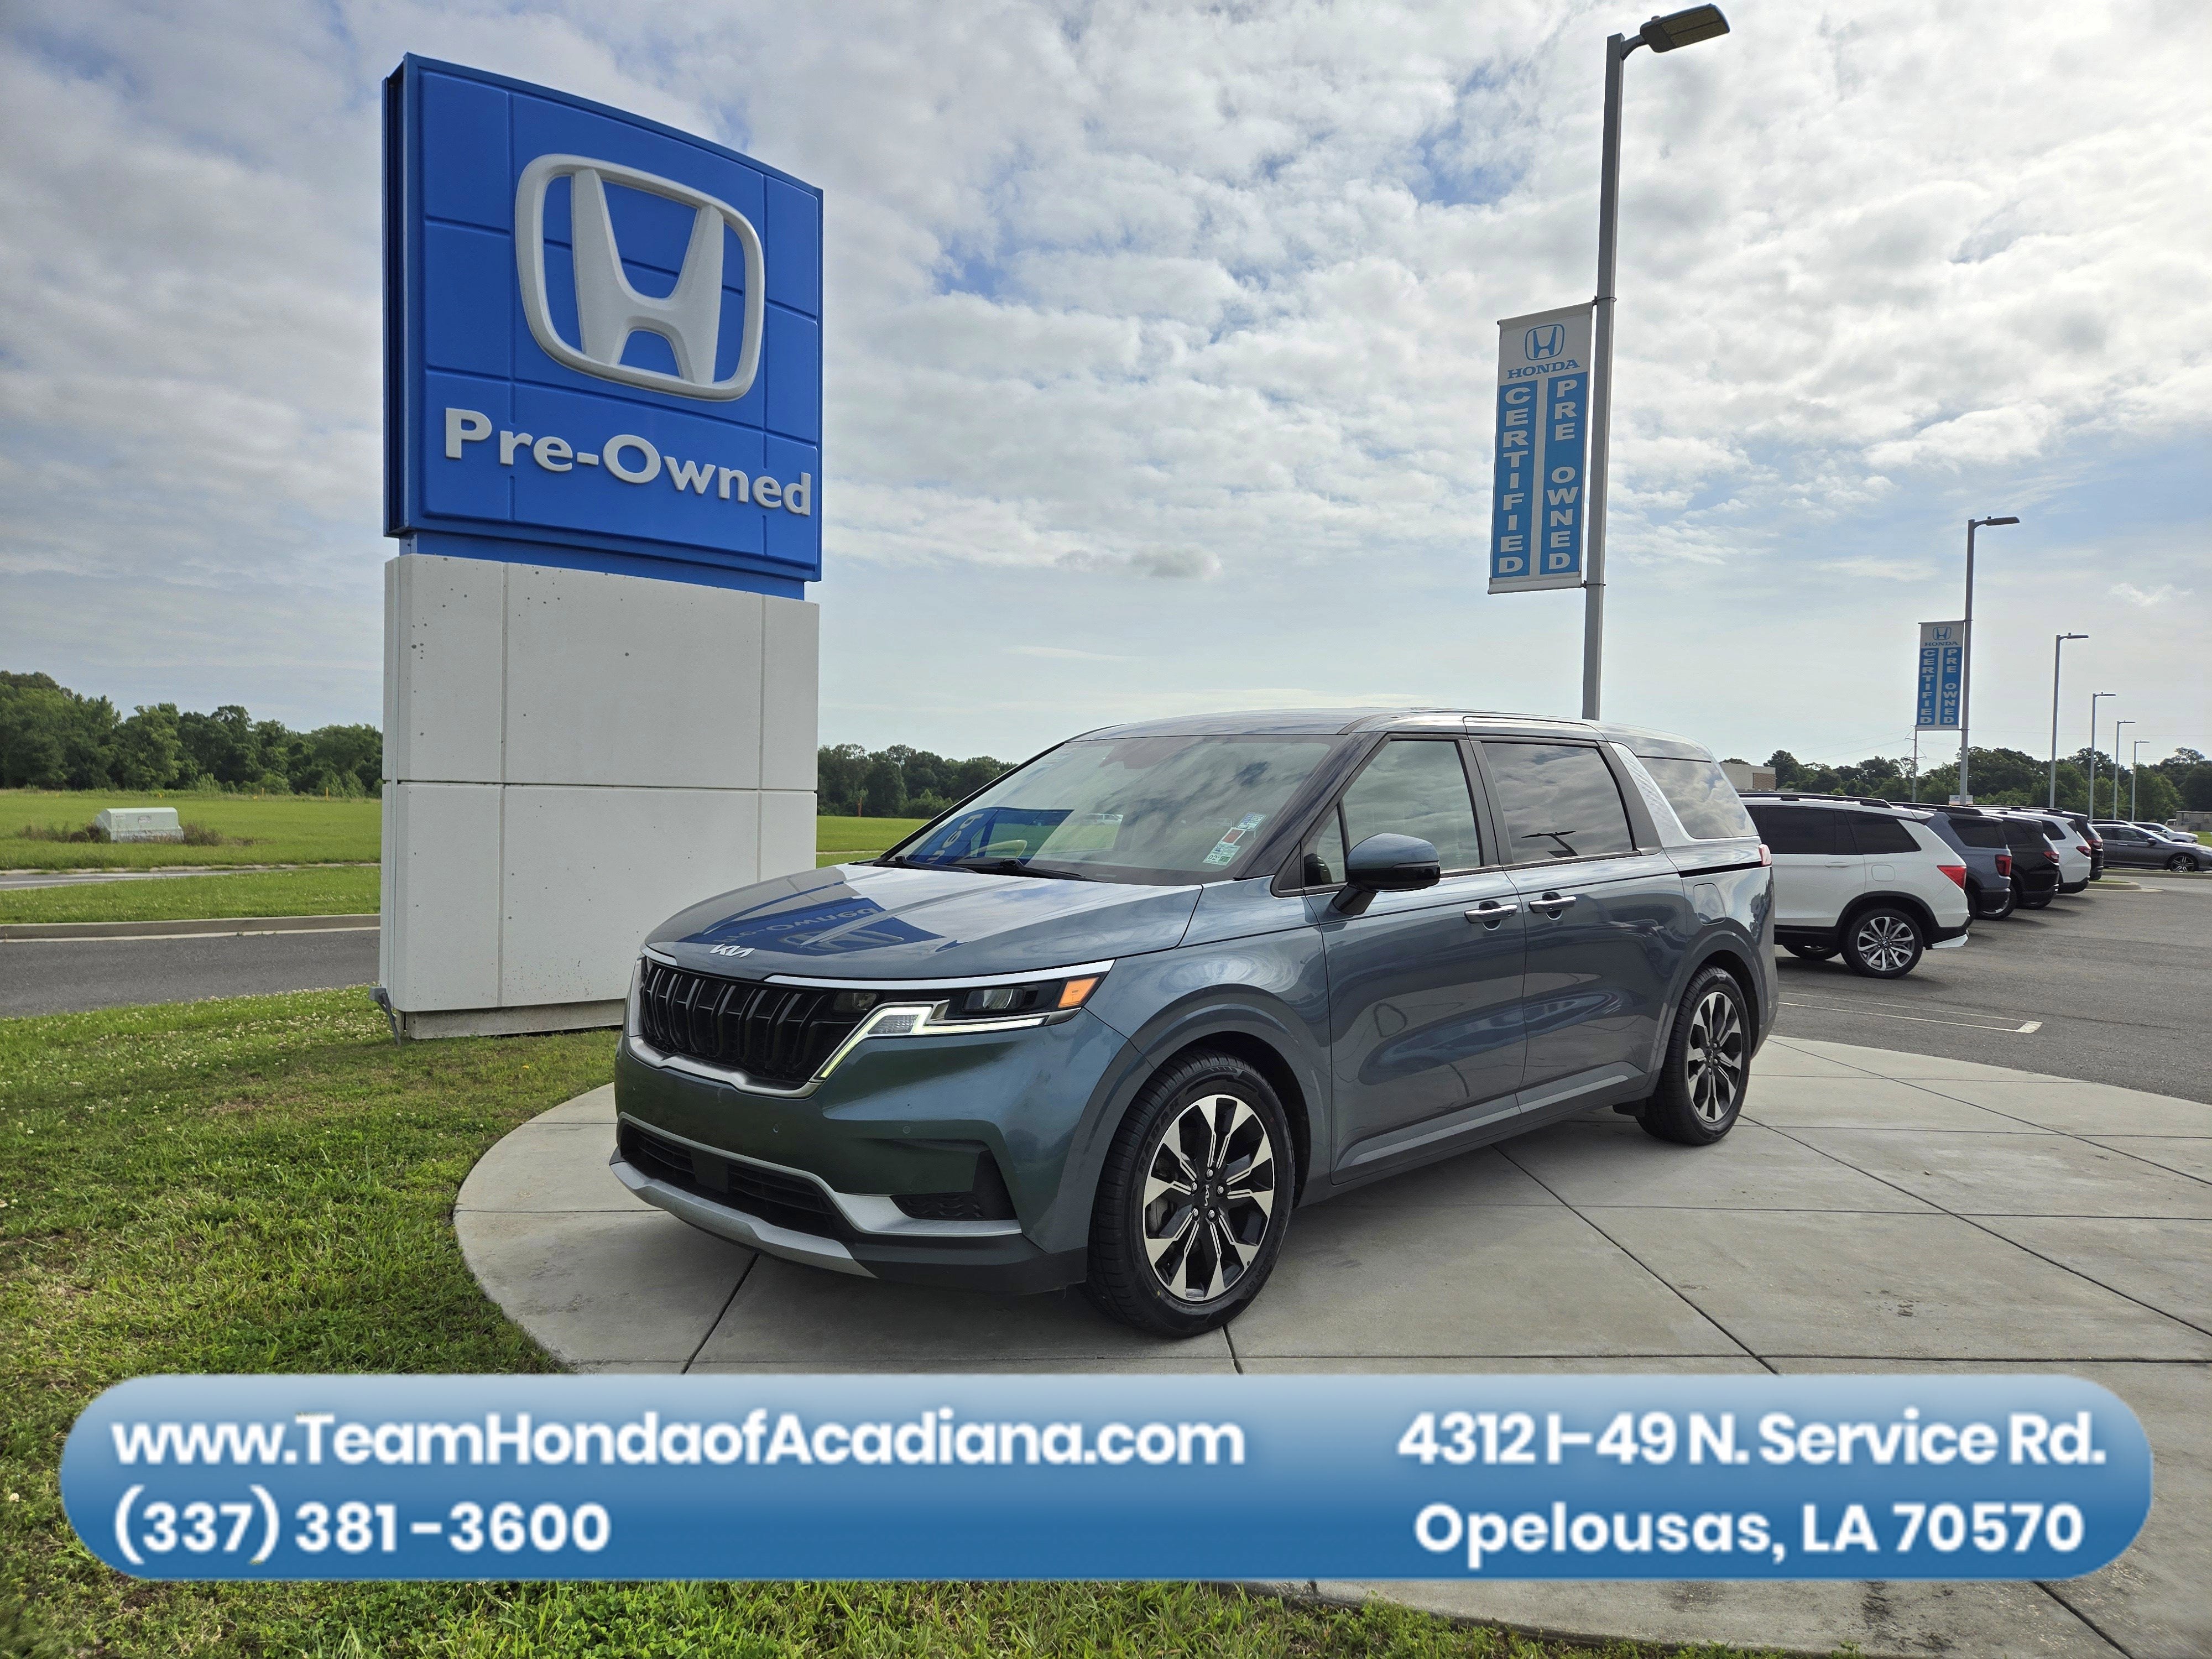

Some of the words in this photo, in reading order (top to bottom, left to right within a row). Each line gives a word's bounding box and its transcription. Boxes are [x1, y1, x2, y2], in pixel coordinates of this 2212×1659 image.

[1507, 359, 1580, 379] HONDA
[1554, 379, 1577, 441] PRE
[445, 407, 811, 517] Pre-Owned
[1498, 387, 1531, 574] CERTIFIED
[1547, 466, 1579, 570] OWNED
[1919, 649, 1936, 724] CERTIFIED
[1946, 649, 1958, 673] PRE
[1943, 682, 1958, 723] OWNED
[709, 943, 755, 958] KIA
